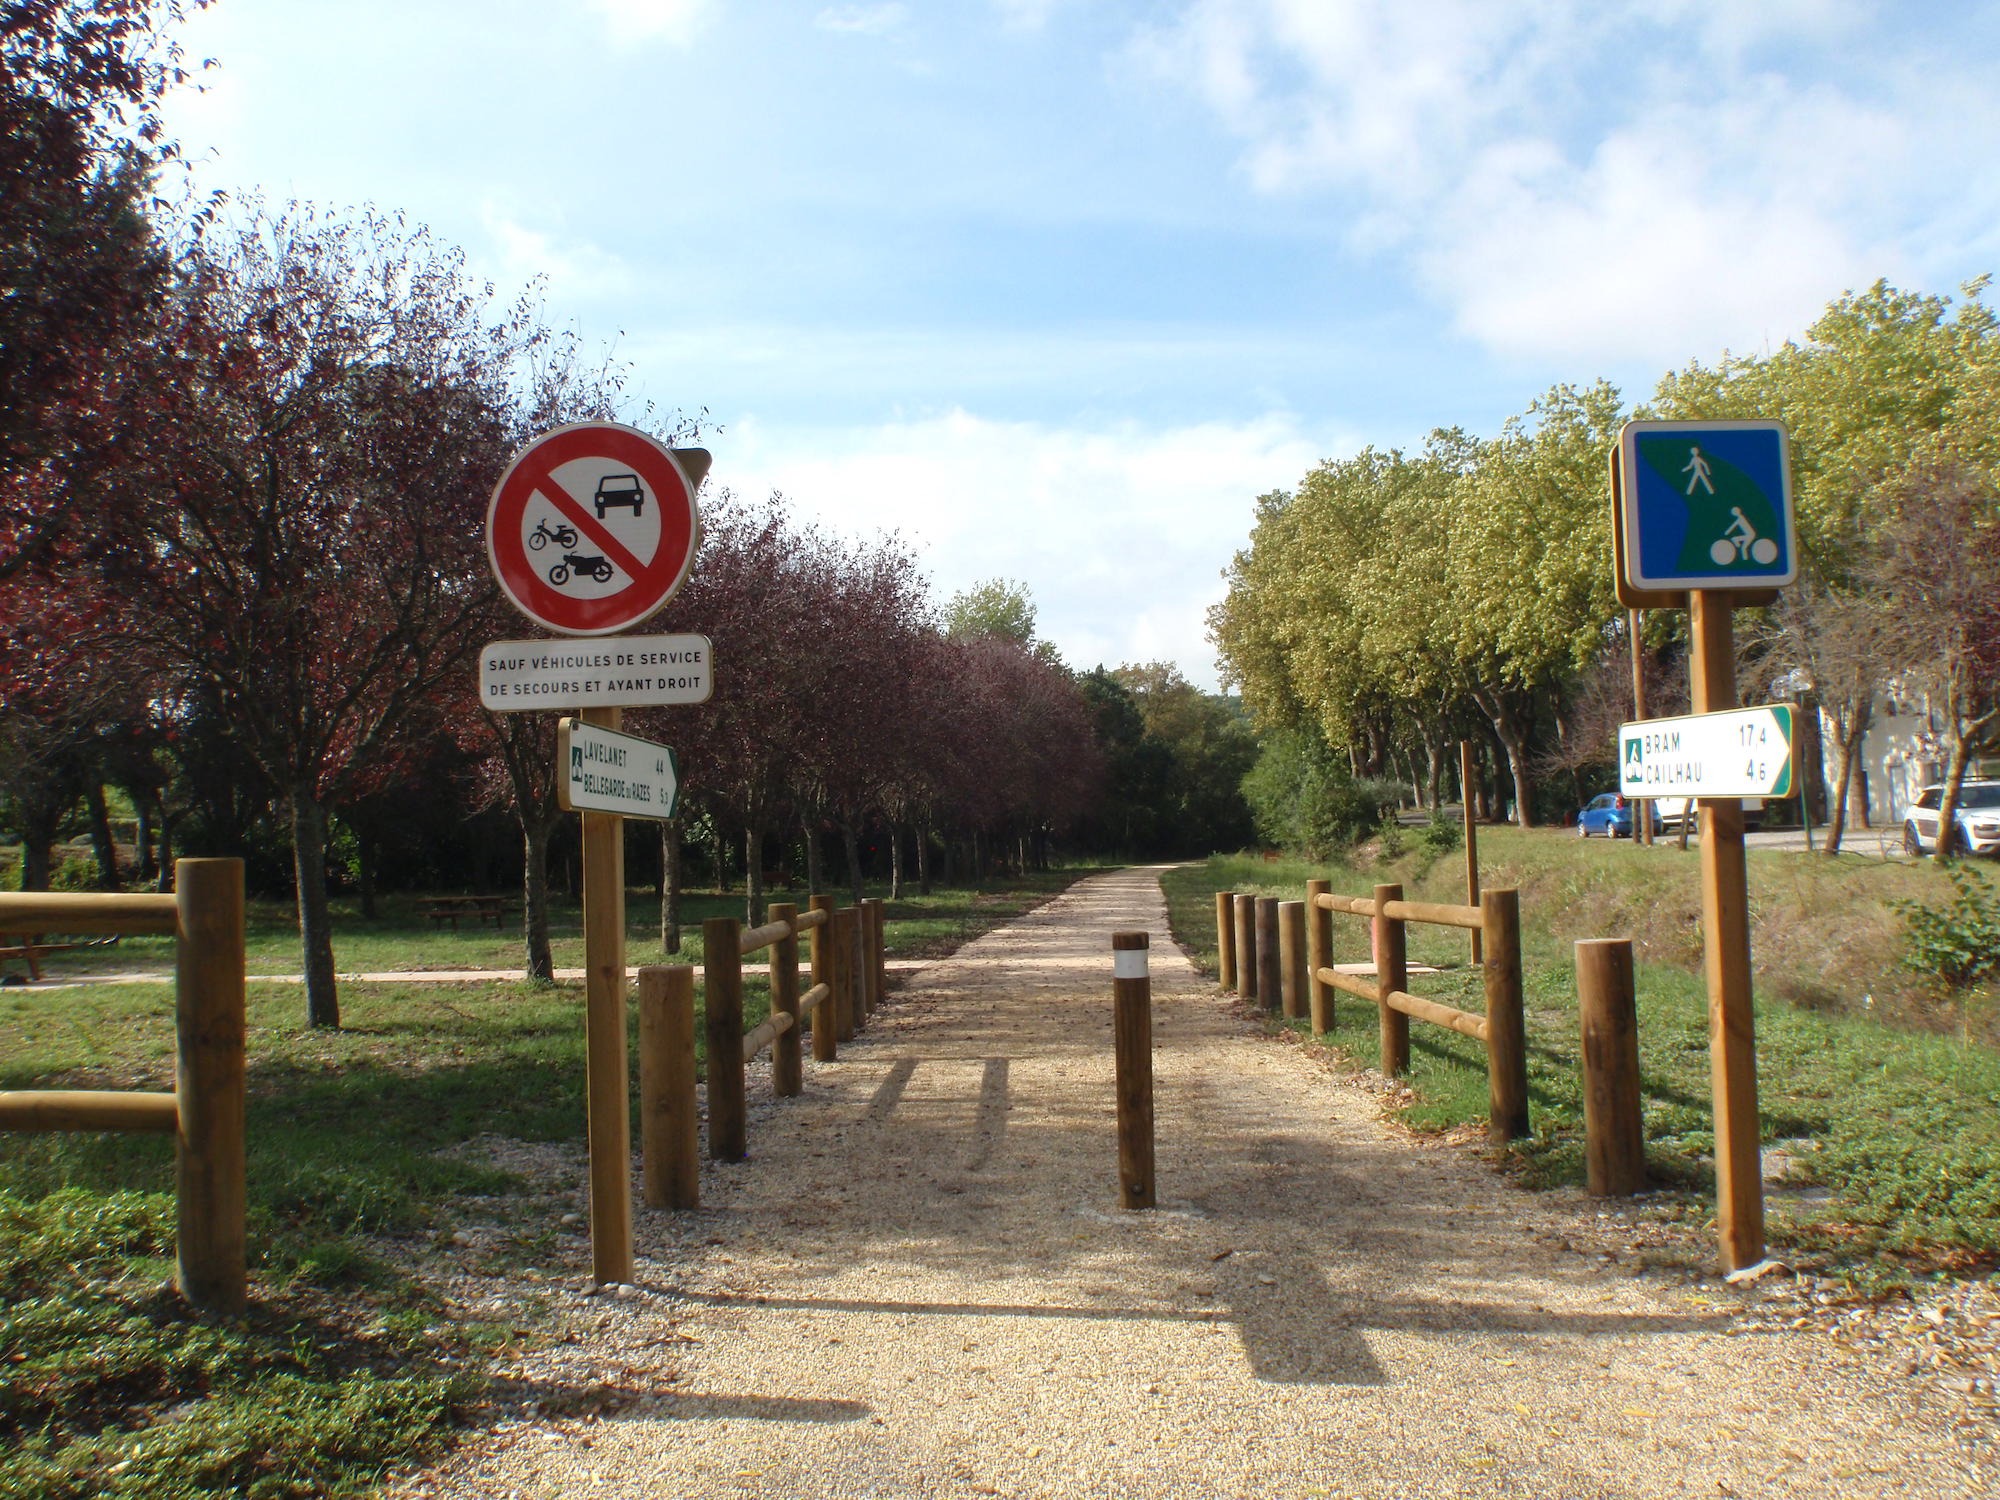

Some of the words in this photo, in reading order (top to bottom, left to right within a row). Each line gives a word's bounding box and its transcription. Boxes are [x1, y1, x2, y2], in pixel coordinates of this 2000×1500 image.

[489, 659, 525, 671] SAUF
[532, 655, 611, 670] VÉHICULES
[617, 654, 635, 666] DE
[640, 651, 701, 665] SERVICE
[490, 684, 508, 696] DE
[514, 681, 580, 696] SECOURS
[585, 680, 601, 693] ET
[608, 678, 652, 692] AYANT
[658, 676, 700, 690] DROIT
[1645, 731, 1680, 754] BRAM
[584, 740, 627, 769] LAVELANET
[656, 759, 664, 776] 44
[1646, 761, 1702, 784] CAILHAU
[584, 773, 625, 799] BELLEGARDE
